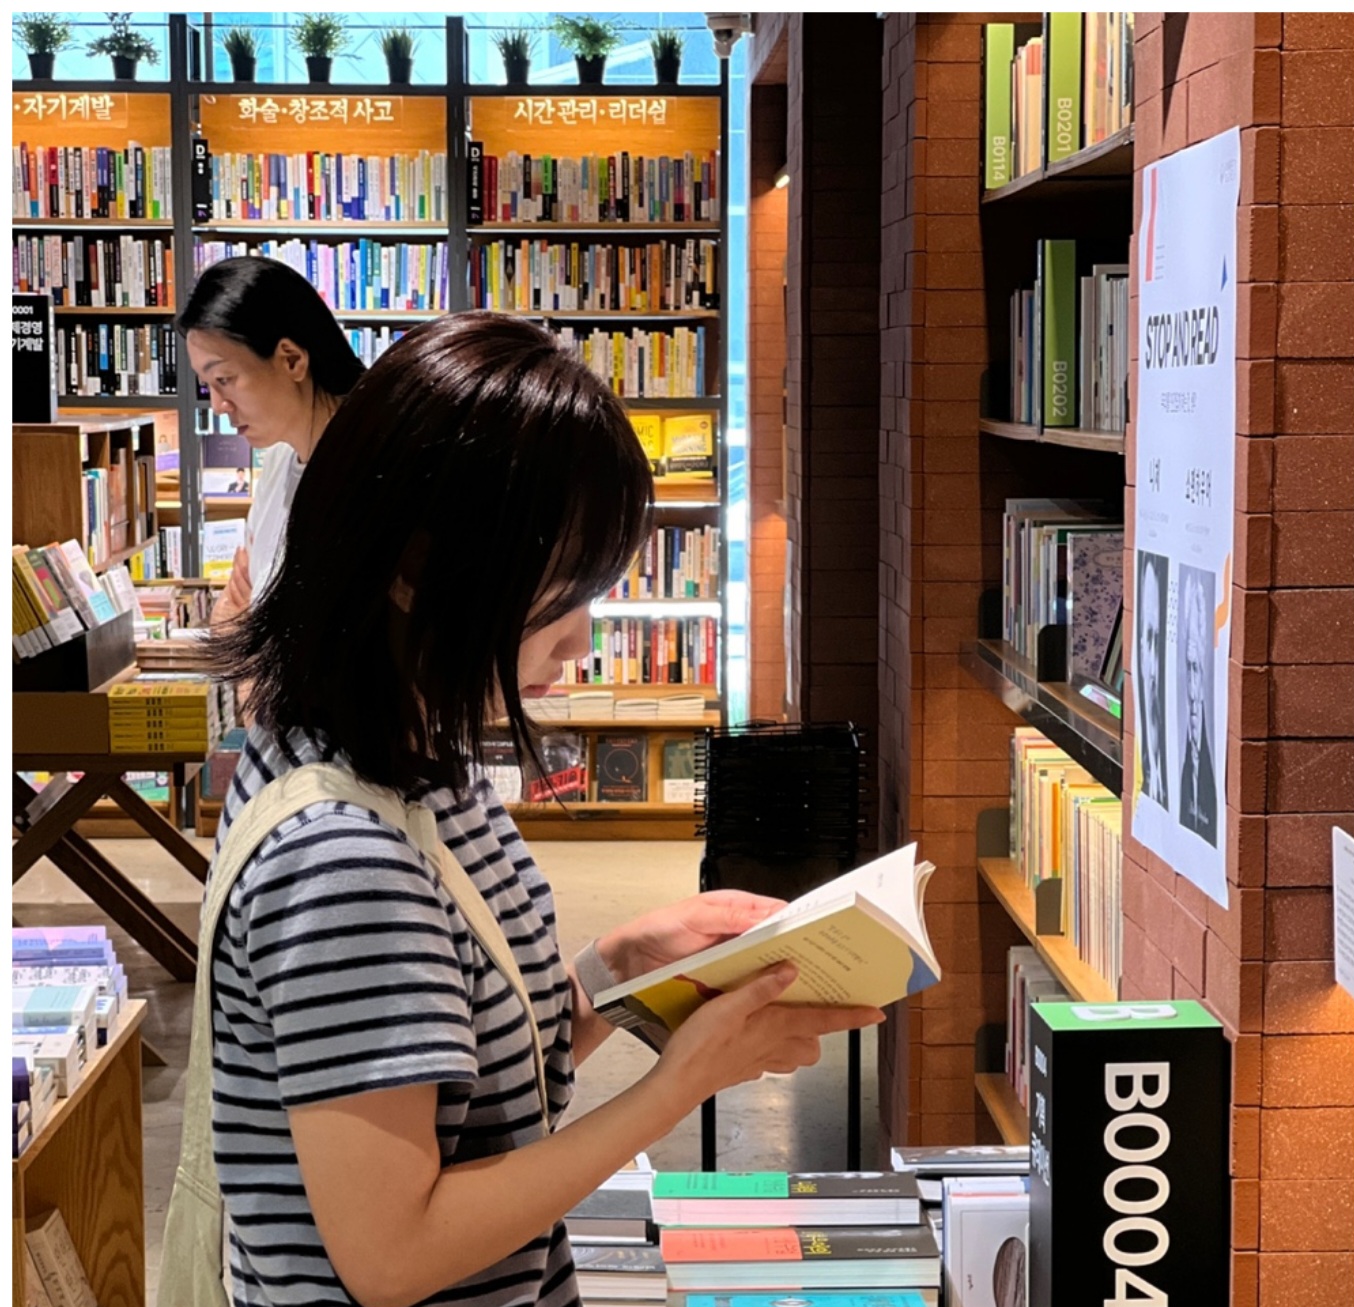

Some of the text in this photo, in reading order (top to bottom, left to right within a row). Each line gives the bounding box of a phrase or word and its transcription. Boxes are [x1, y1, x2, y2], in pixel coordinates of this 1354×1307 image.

[353, 98, 394, 124] 사고
[514, 99, 555, 125] 시간
[1057, 98, 1072, 153] B0201
[992, 136, 1006, 181] B0114
[1146, 306, 1219, 369] STOP AND READ
[1053, 361, 1067, 417] B0202
